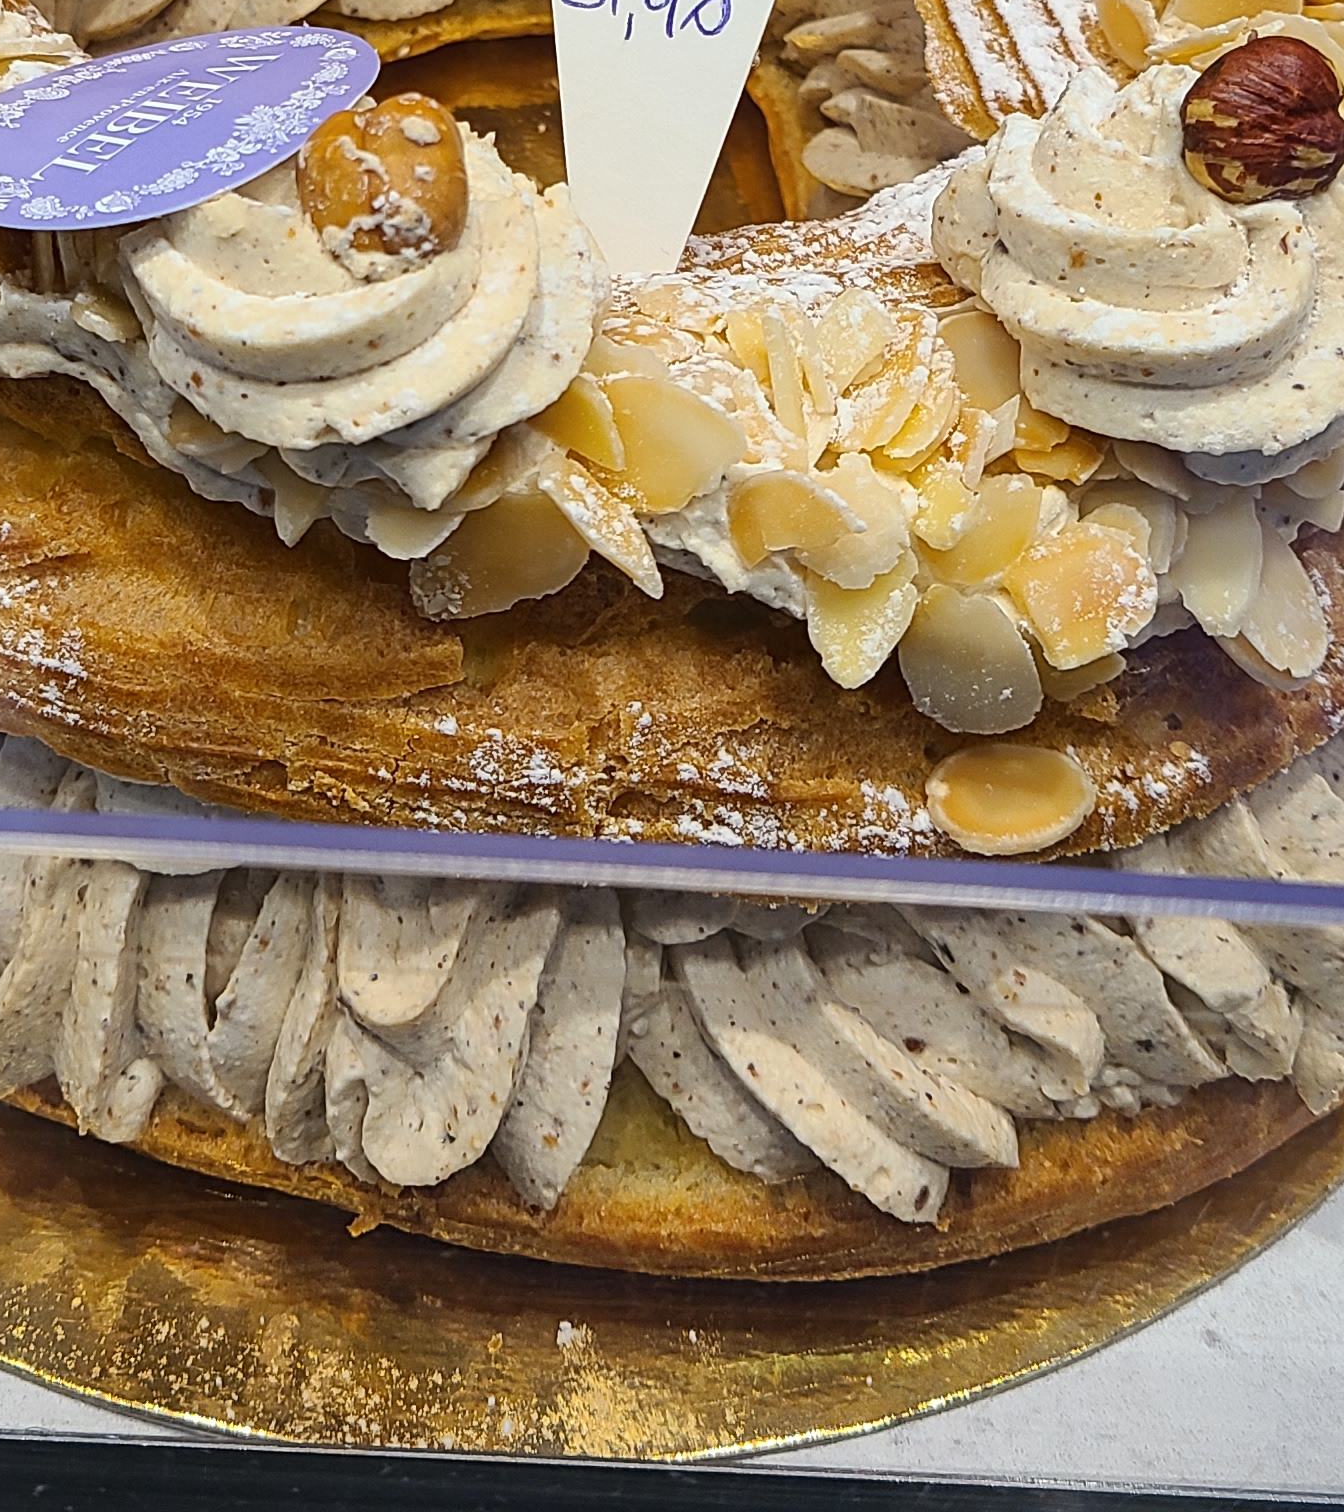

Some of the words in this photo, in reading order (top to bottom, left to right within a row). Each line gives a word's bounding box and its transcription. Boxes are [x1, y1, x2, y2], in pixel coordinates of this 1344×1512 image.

[31, 52, 285, 181] WEIBEL
[57, 69, 190, 144] Aix-en-Provence
[171, 97, 223, 126] 1954
